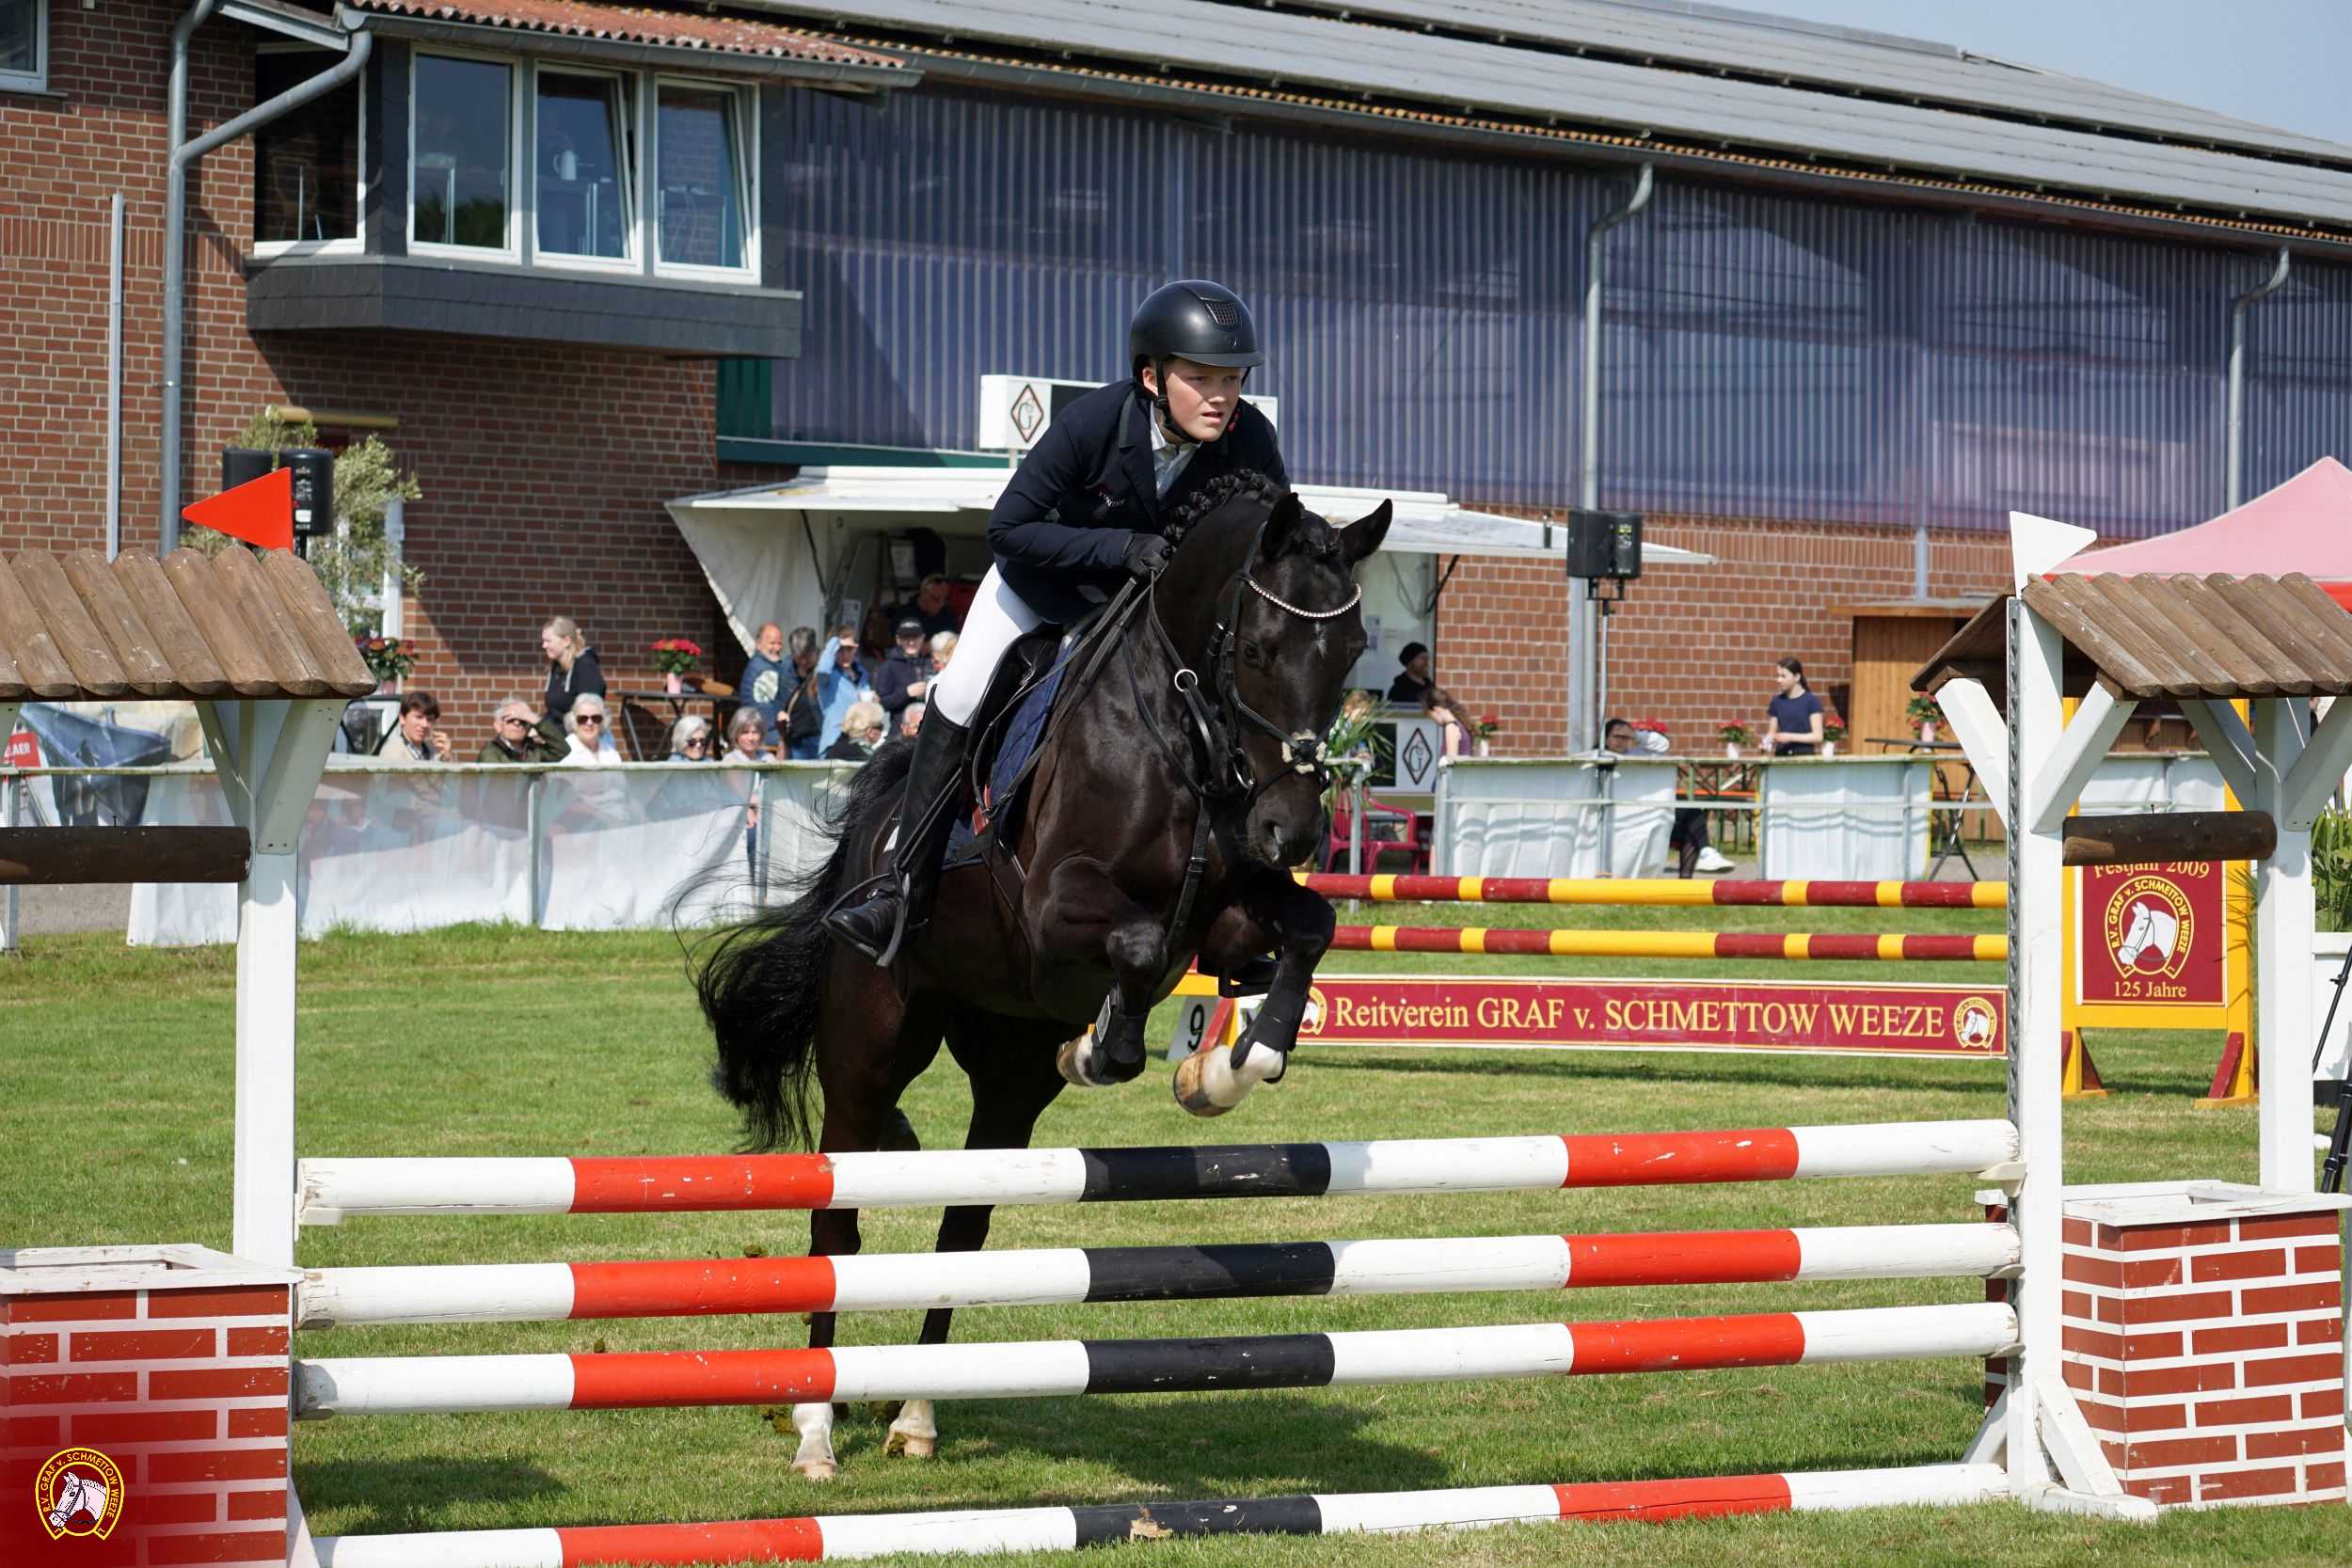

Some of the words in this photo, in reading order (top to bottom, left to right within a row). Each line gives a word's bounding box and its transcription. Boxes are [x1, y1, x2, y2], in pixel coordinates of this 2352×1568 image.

[2166, 861, 2210, 879] 2009
[2108, 894, 2124, 925] GRAF
[2134, 879, 2189, 916] SCHMETTOW
[2176, 920, 2190, 953] WEEZE
[2114, 981, 2141, 997] 125
[2145, 981, 2187, 998] Jahre
[1187, 1004, 1205, 1052] 9
[1334, 996, 1470, 1028] Reitverein
[1476, 997, 1565, 1030] GRAF
[1573, 1006, 1596, 1030] v.
[1604, 999, 1820, 1035] SCHMETTOW
[1828, 1004, 1947, 1038] WEEZE
